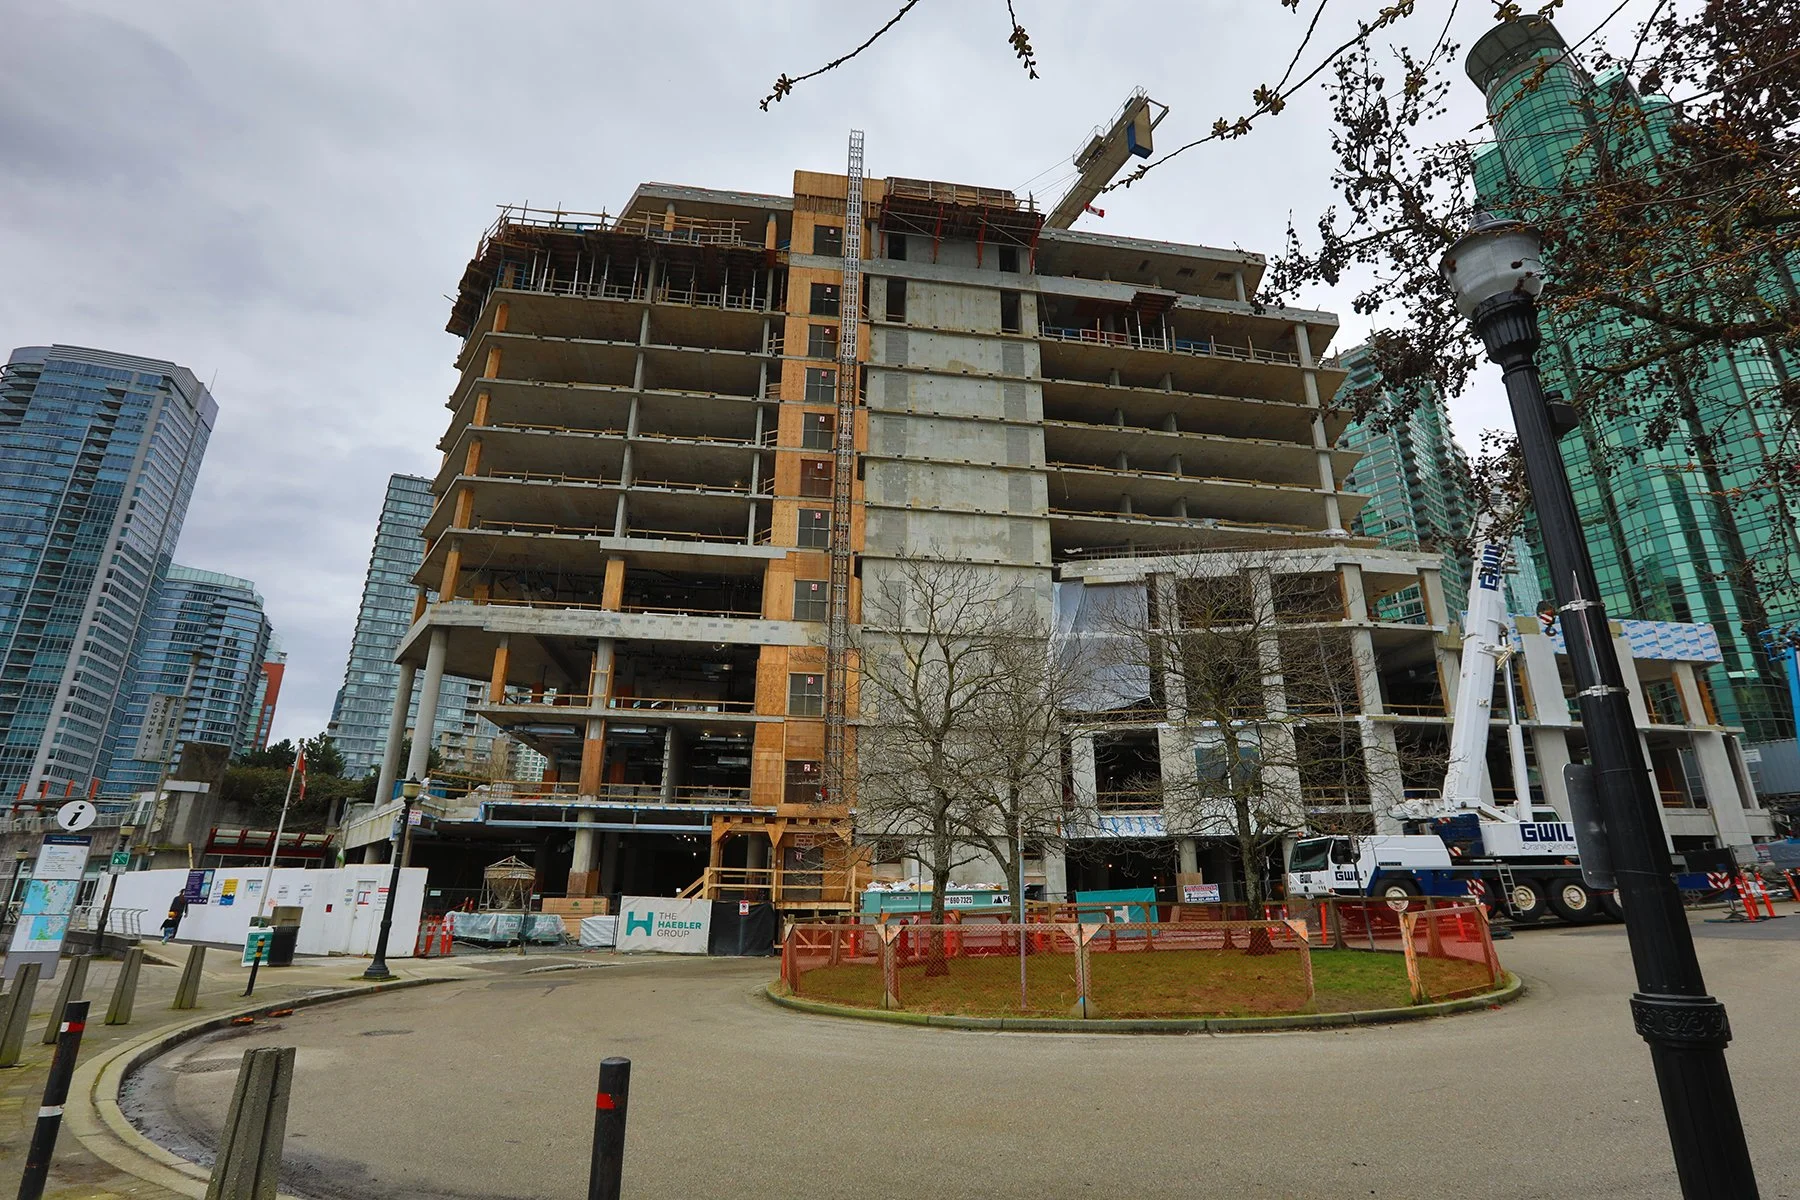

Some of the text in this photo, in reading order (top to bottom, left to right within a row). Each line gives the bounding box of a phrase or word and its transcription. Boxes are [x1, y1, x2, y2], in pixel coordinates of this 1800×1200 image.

[141, 701, 161, 759] COMMUNITY
[1519, 823, 1575, 842] GWIL
[659, 912, 677, 920] THE
[658, 921, 702, 930] HAEBLER
[656, 929, 690, 938] GROUP
